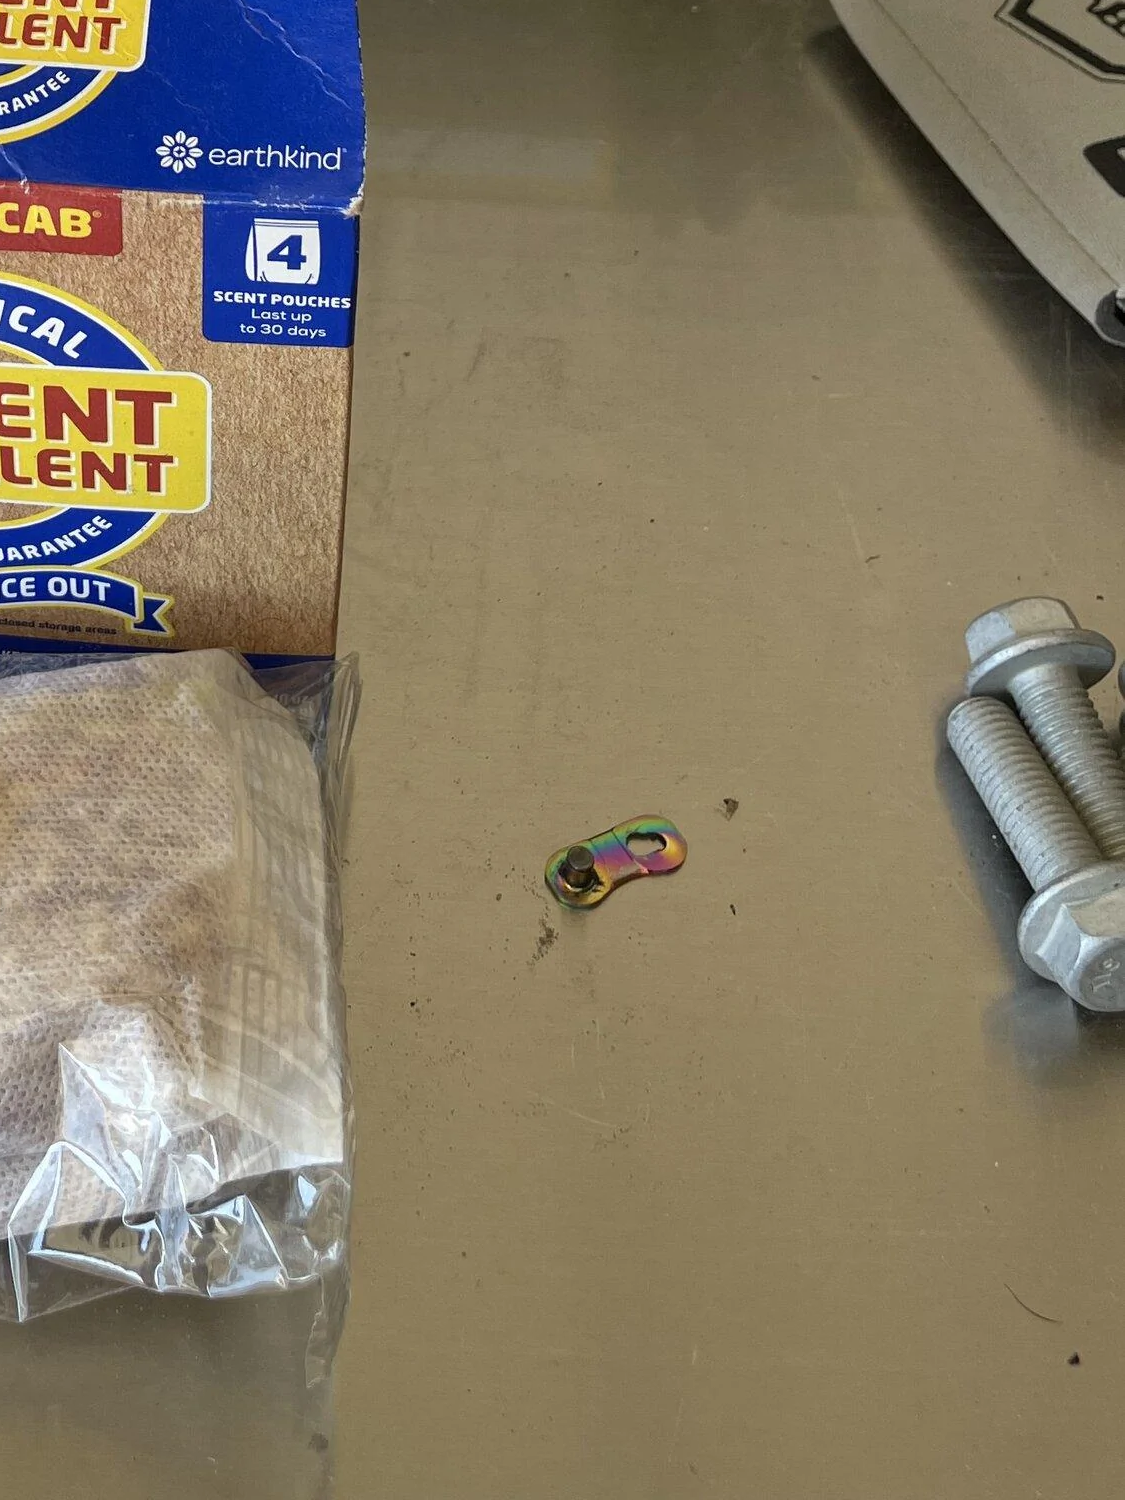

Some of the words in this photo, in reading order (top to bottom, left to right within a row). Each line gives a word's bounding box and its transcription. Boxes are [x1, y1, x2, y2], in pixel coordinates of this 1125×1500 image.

[208, 144, 343, 171] earthkind
[266, 234, 308, 271] 4
[213, 290, 268, 305] SCENT
[271, 293, 352, 309] POUCHES
[251, 308, 288, 321] Last
[290, 311, 313, 326] up
[239, 323, 257, 334] to
[259, 323, 284, 336] 30
[287, 325, 328, 339] days
[47, 576, 112, 603] OUT
[38, 621, 82, 634] storage
[85, 626, 117, 636] areas
